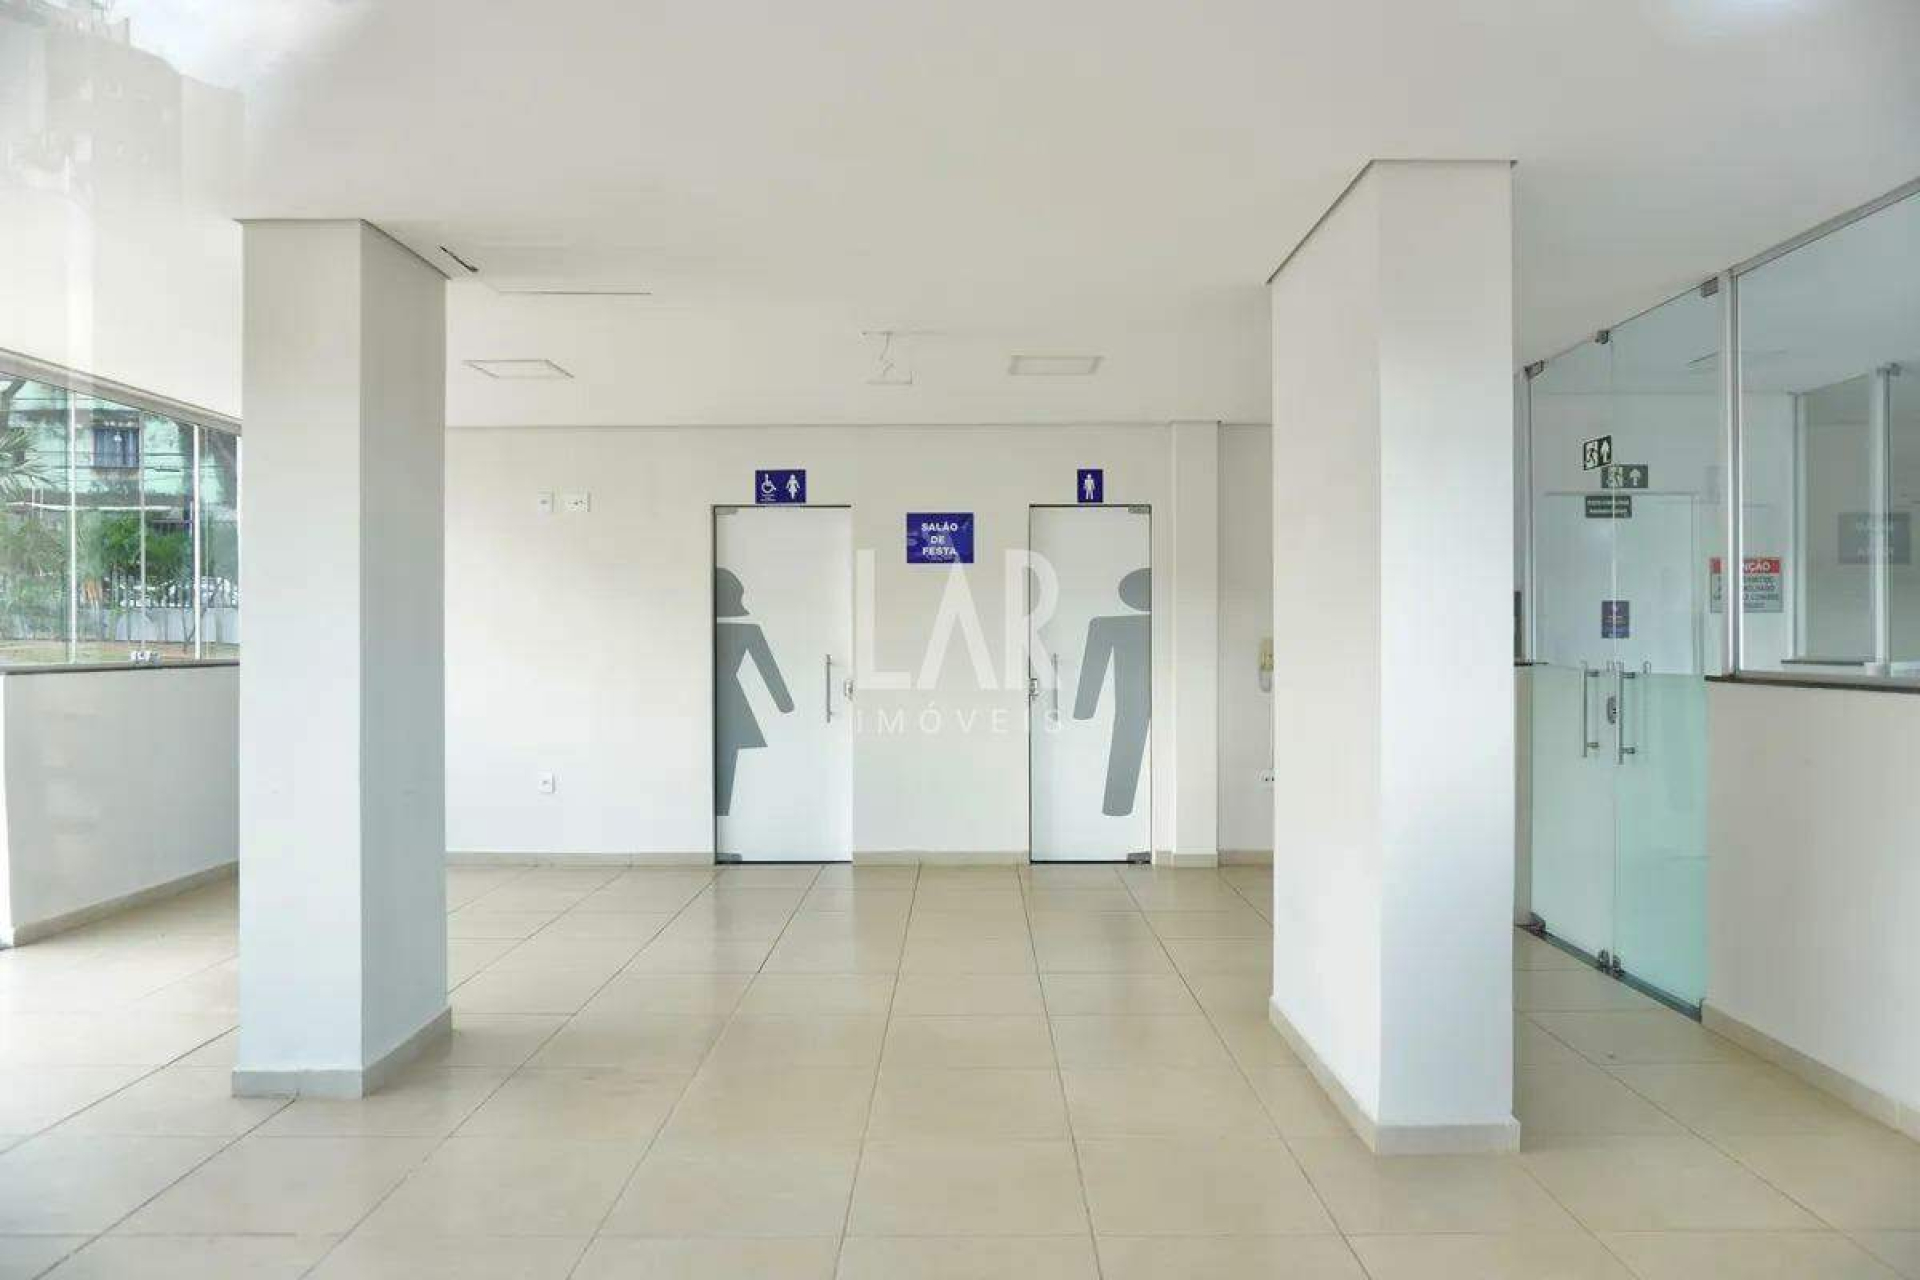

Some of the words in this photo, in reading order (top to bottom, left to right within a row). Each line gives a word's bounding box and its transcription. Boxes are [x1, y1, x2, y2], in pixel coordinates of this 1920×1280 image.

[921, 521, 959, 531] SALÃO
[930, 535, 946, 545] DE
[922, 546, 957, 556] FESTA
